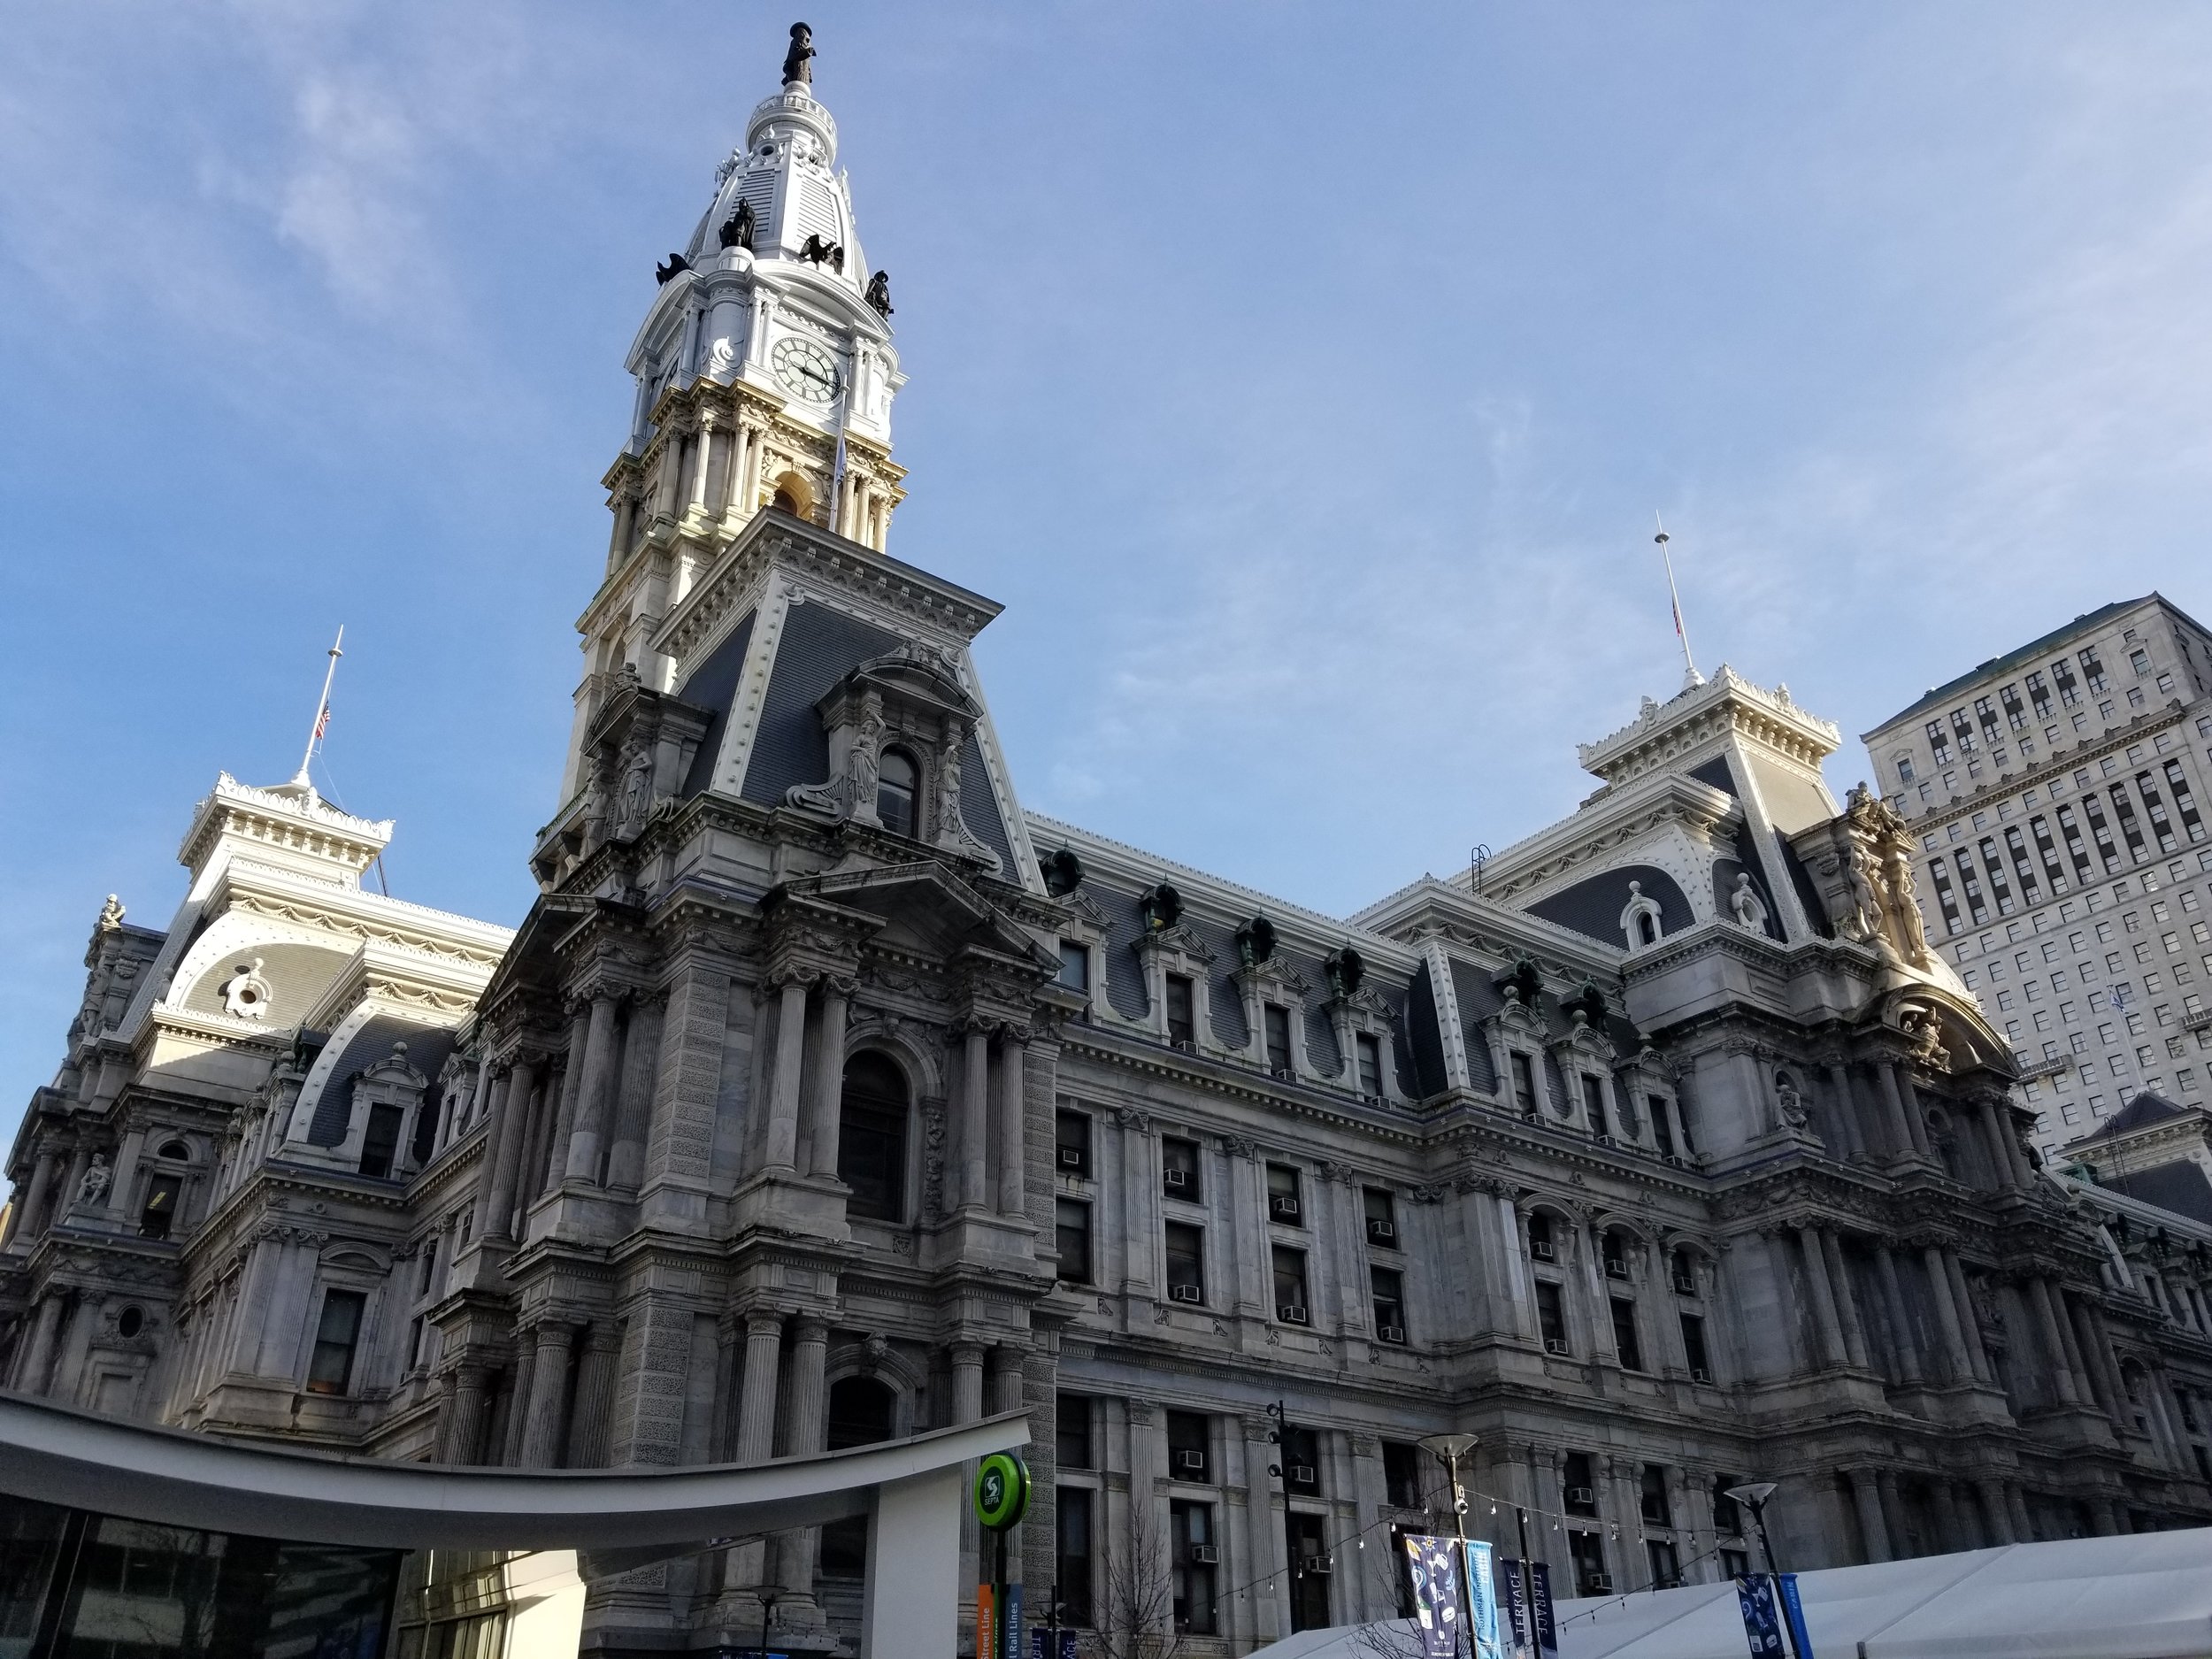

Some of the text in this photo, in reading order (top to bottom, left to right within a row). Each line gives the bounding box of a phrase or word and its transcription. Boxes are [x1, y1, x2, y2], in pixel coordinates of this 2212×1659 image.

[985, 1497, 1000, 1506] SEPTA
[1509, 1571, 1525, 1634] TERRACE
[1533, 1574, 1548, 1635] TERRACE
[981, 1608, 990, 1629] Line
[1010, 1602, 1018, 1630] Lines
[1009, 1632, 1018, 1652] Rail
